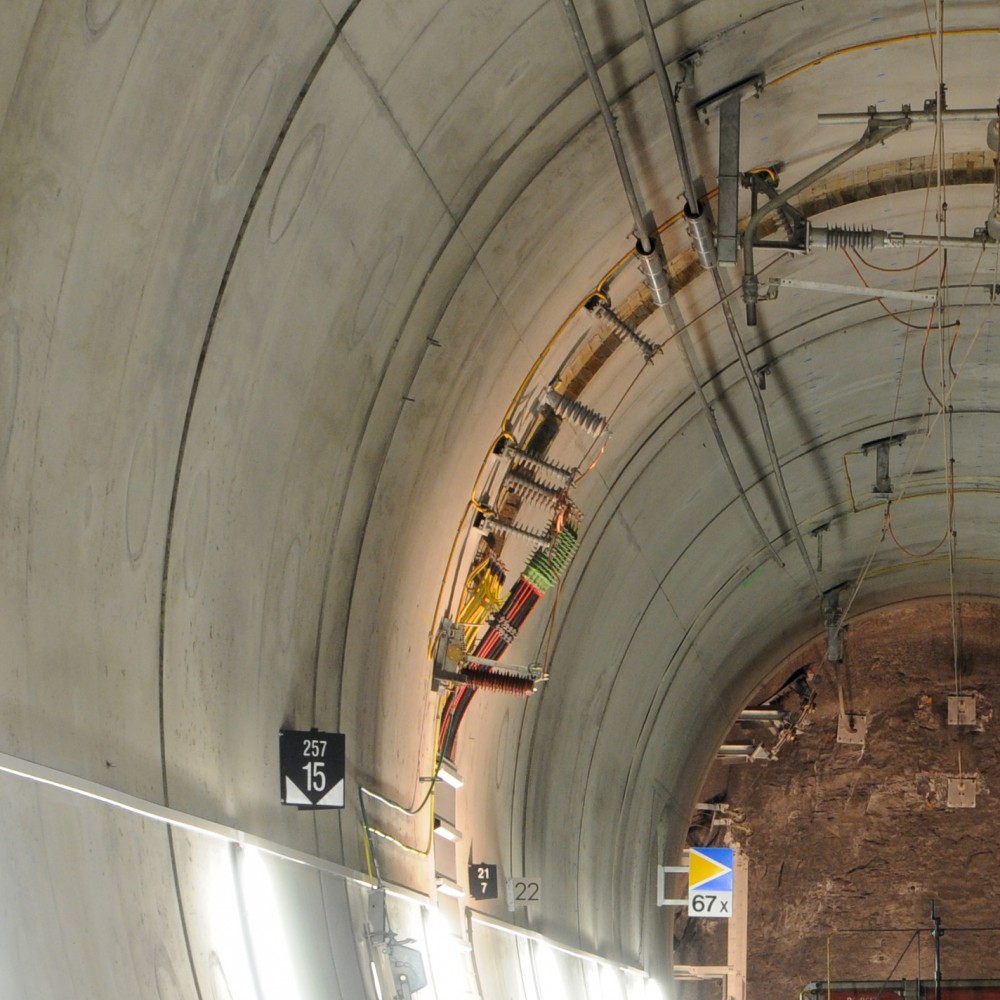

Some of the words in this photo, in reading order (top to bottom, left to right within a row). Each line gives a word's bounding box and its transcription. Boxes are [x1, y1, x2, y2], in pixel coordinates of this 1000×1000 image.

[303, 739, 328, 757] 257
[302, 762, 326, 791] 15
[477, 868, 489, 879] 21
[481, 882, 488, 893] 7
[515, 882, 539, 901] 22
